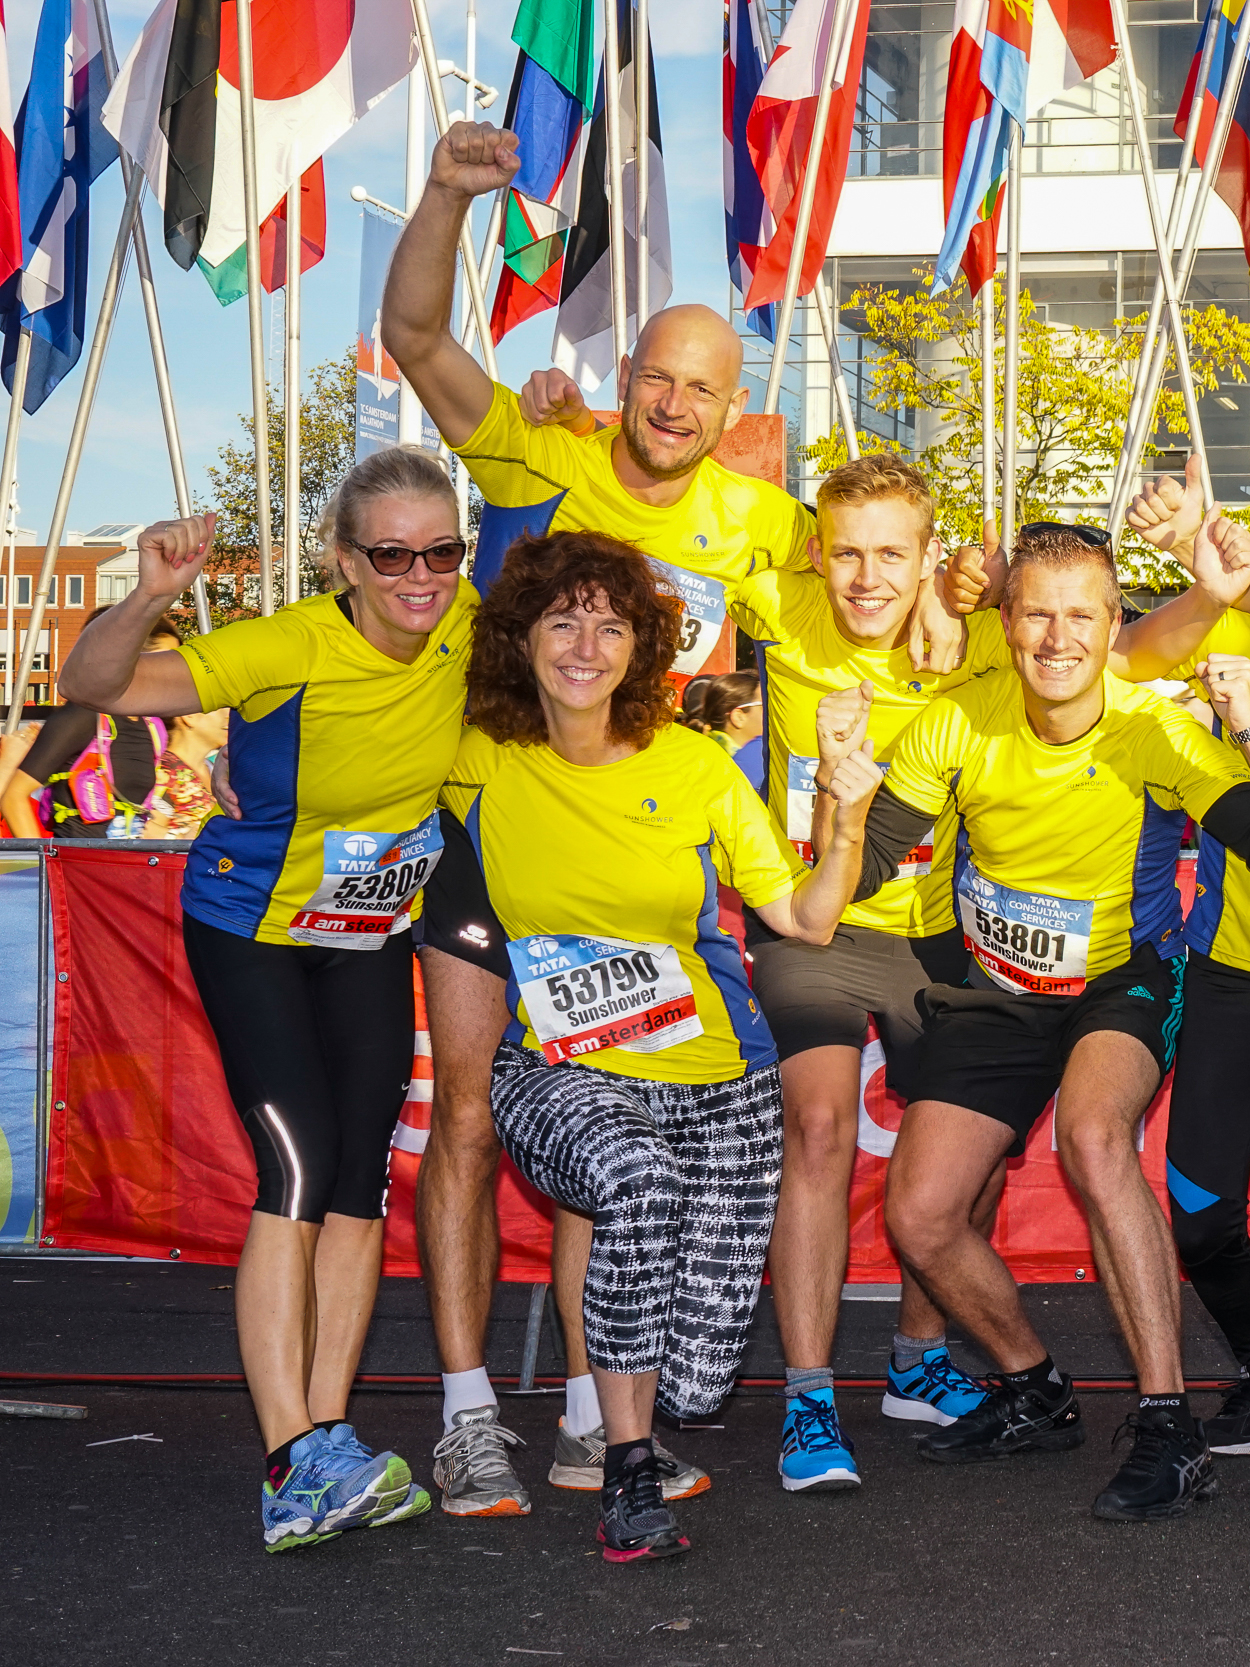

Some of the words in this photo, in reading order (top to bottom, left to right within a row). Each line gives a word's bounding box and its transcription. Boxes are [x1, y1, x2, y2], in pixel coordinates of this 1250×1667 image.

[680, 573, 706, 591] TATA
[400, 842, 425, 859] RVICES
[338, 859, 376, 872] TATA
[333, 857, 429, 901] 53809
[967, 889, 998, 912] TATA
[1009, 900, 1081, 921] CONSULTANCY
[1030, 896, 1060, 909] TATA
[299, 913, 313, 927] I
[1021, 913, 1066, 929] SERVICES
[975, 907, 1066, 962] 53801
[983, 936, 1054, 973] Sunshower
[528, 956, 571, 977] TATA
[978, 951, 1071, 993] amsterdam
[546, 950, 660, 1013] 53790
[1127, 990, 1155, 1001] adidas
[567, 986, 657, 1027] Sunshower
[552, 1042, 566, 1060] I
[569, 1007, 682, 1055] amsterdam
